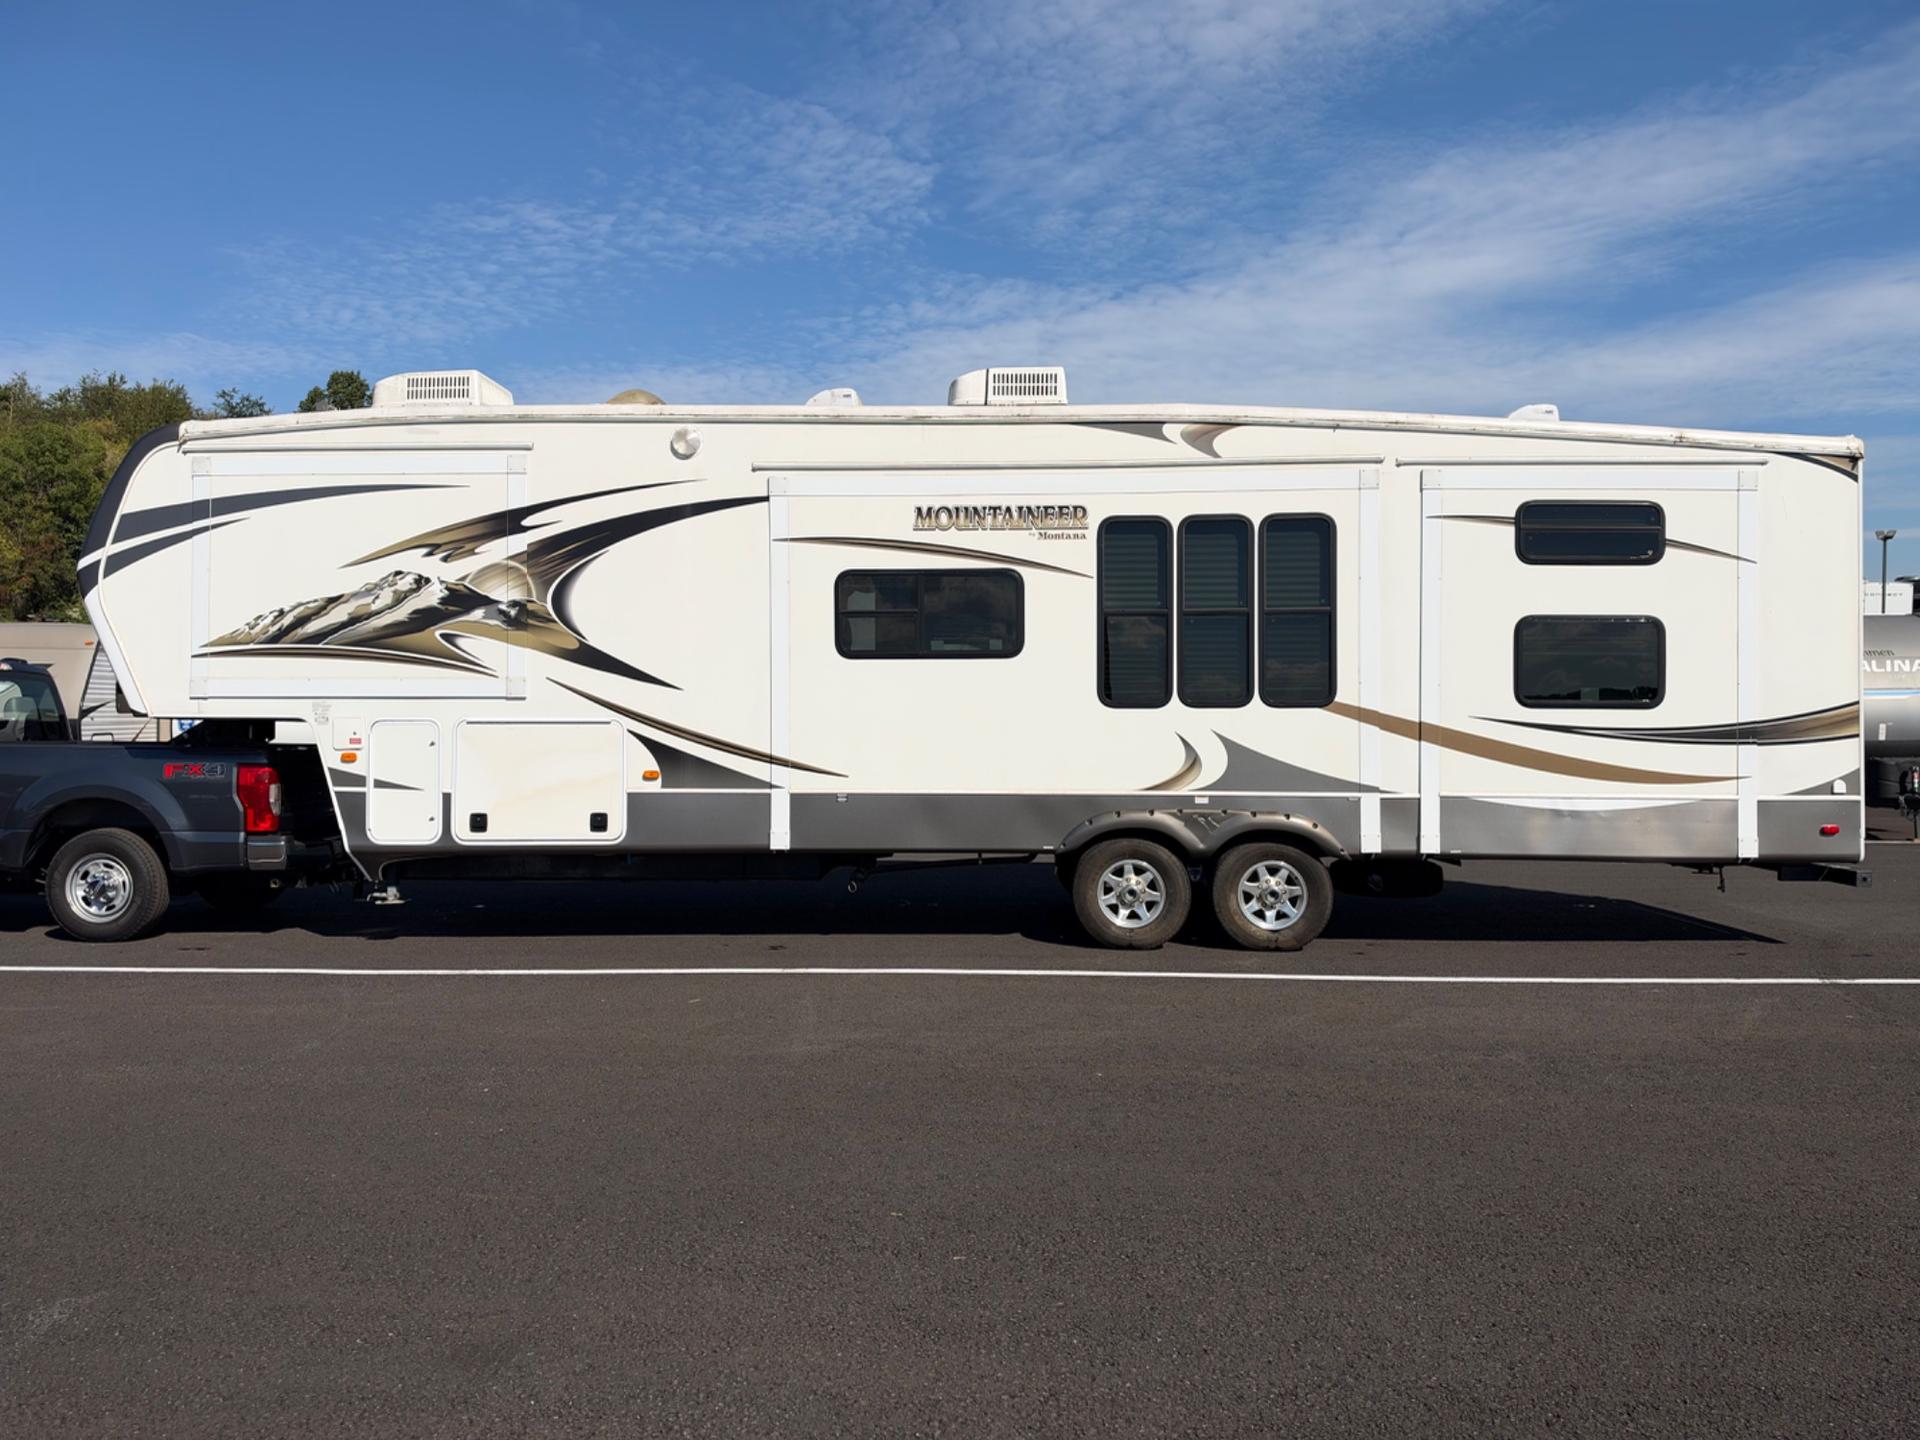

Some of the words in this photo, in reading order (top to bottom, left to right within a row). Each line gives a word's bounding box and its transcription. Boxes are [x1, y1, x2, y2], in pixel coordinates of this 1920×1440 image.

[913, 505, 1088, 531] MOUNTAINEER
[1037, 531, 1087, 540] Montana
[163, 762, 227, 779] FX4
